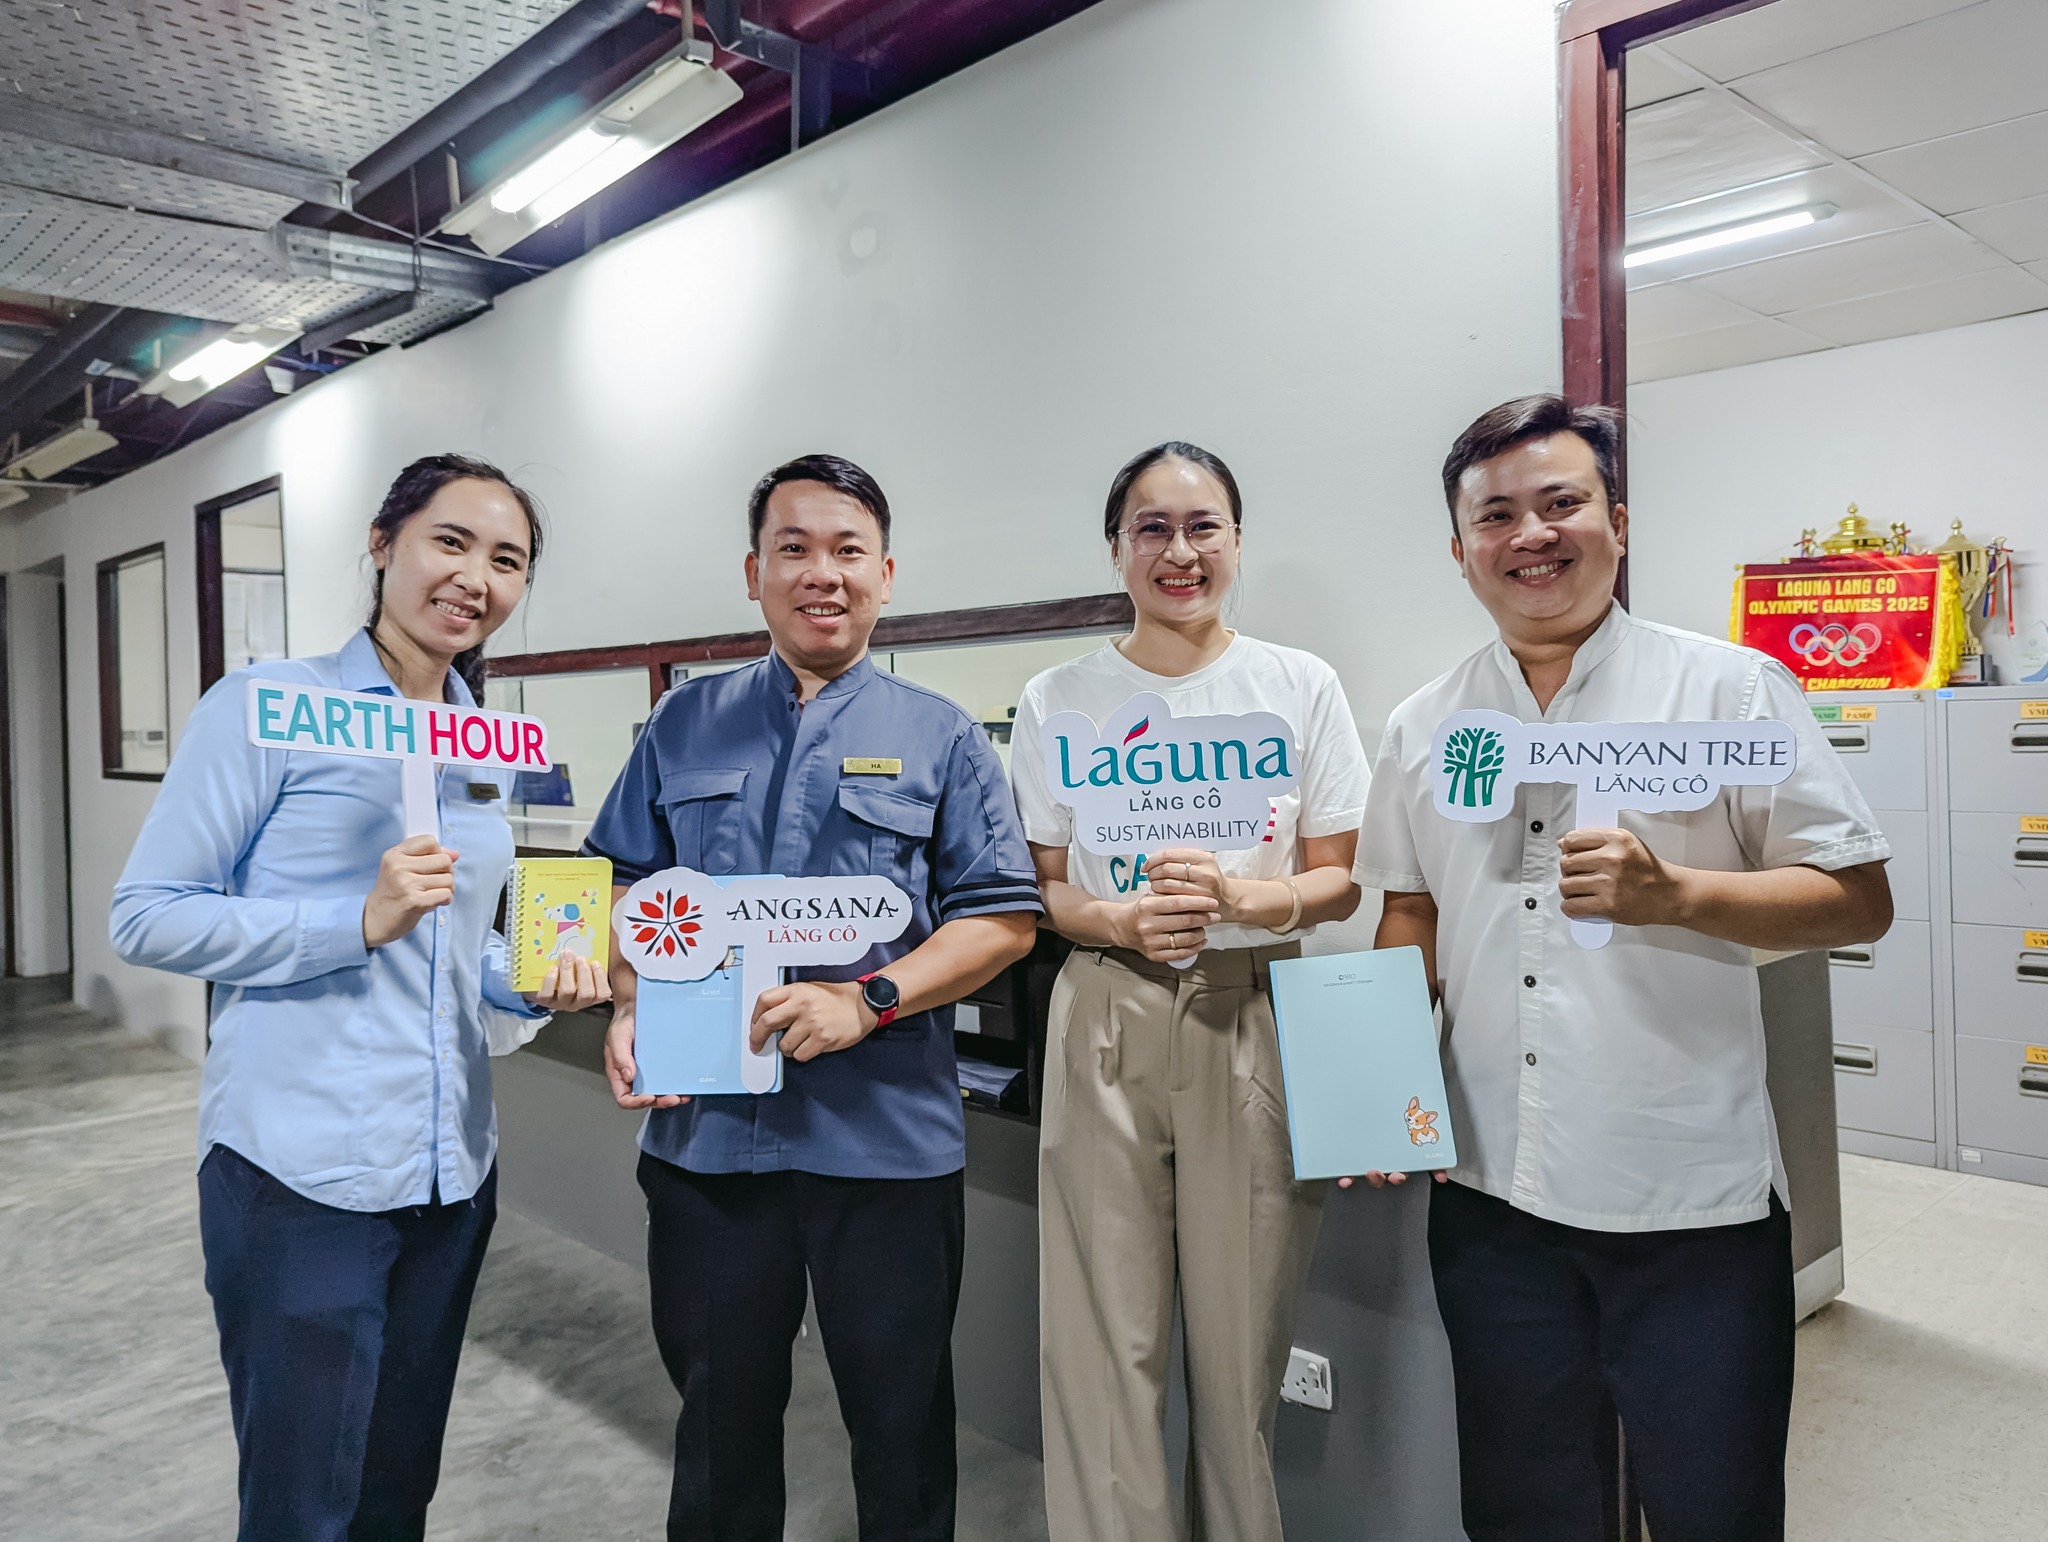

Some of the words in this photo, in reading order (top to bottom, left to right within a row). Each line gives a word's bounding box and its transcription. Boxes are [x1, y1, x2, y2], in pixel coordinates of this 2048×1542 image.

[1777, 580, 1832, 597] LAGUNA
[1835, 579, 1872, 595] LANG
[1875, 577, 1897, 594] CO
[1748, 600, 1819, 615] OLYMPIC
[1822, 598, 1883, 613] GAMES
[1886, 596, 1929, 612] 2025
[1807, 677, 1892, 691] CHAMPION
[257, 688, 415, 754] EARTH
[429, 710, 547, 766] HOUR
[1528, 740, 1687, 766] BANYAN
[1698, 740, 1788, 766] TREE
[1595, 773, 1666, 797] LĂNG
[1673, 773, 1708, 794] CÔ
[1129, 790, 1184, 812] LĂNG
[1193, 787, 1222, 809] CÔ
[1096, 819, 1259, 843] SUSTAINABILITY
[726, 896, 899, 921] ANGSANA
[767, 925, 823, 944] LĂNG
[828, 924, 857, 943] CÔ
